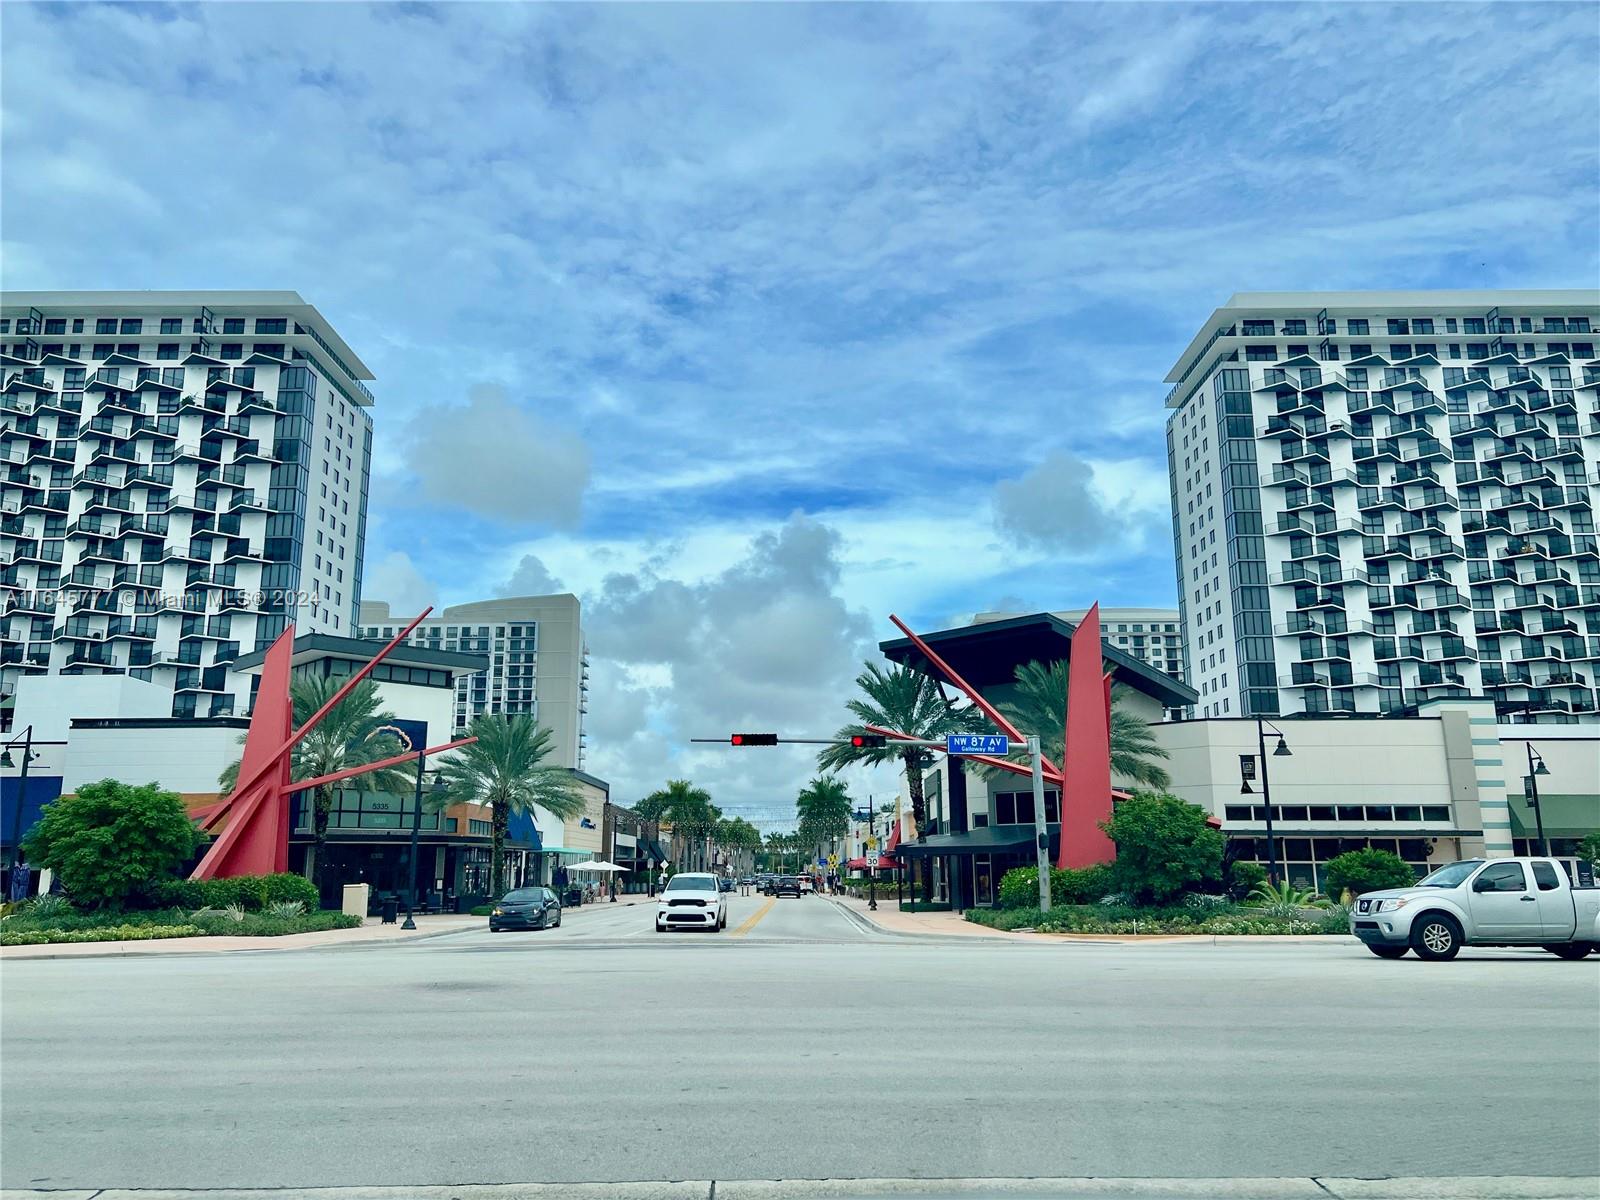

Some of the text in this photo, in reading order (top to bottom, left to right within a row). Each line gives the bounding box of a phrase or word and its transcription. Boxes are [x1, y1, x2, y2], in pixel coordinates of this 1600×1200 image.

[954, 736, 1002, 747] NW 87 AV
